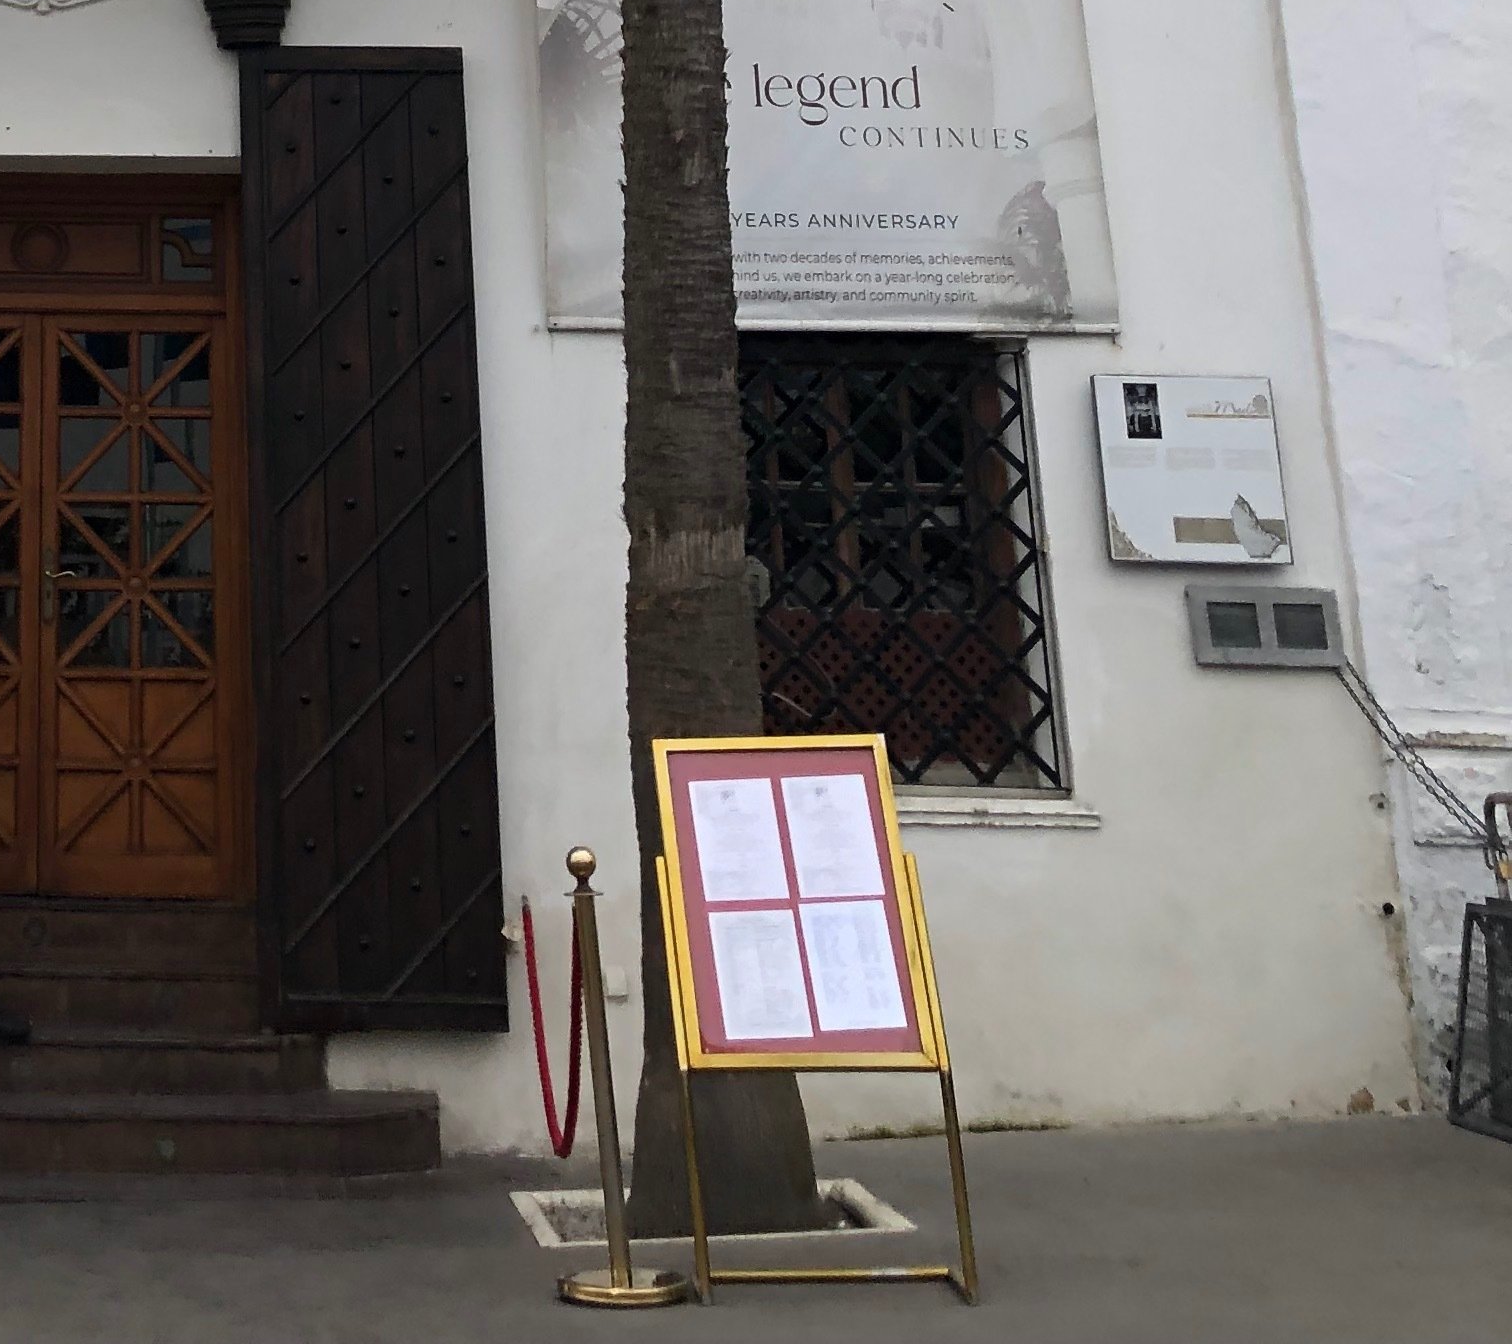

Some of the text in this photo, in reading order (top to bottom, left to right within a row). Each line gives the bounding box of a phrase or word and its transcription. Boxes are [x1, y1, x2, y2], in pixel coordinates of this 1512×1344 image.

[752, 63, 922, 126] legend
[839, 125, 1031, 150] CONTINUES
[731, 212, 960, 230] YEARS ANNIVERSARY
[731, 251, 1015, 267] with two decades of memories, achievements,
[763, 272, 780, 283] us,
[784, 273, 801, 282] we
[804, 270, 852, 283] embark
[855, 273, 872, 283] on
[875, 273, 882, 282] a
[885, 271, 943, 286] year-long
[946, 271, 1020, 285] celebration,
[842, 289, 866, 301] and
[869, 289, 941, 304] community
[944, 289, 978, 304] spirit.
